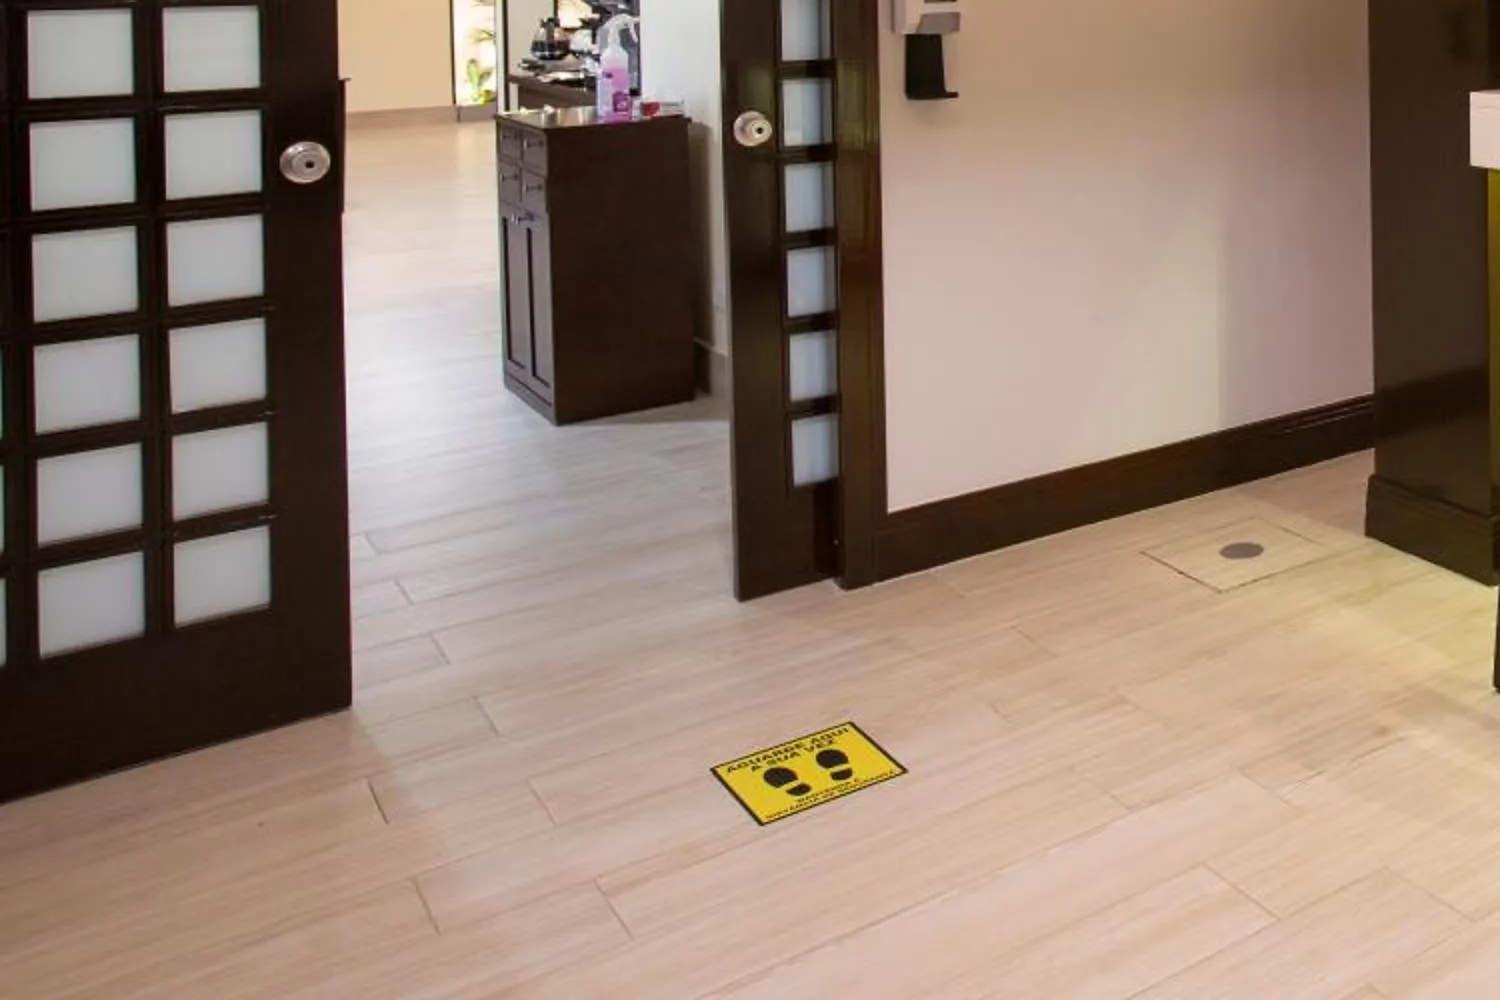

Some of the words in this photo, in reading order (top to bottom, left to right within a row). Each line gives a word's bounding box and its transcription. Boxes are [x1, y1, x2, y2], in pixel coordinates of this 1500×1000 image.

[727, 741, 805, 772] AGUARDE
[811, 727, 849, 745] AQUI
[766, 751, 801, 765] SUA
